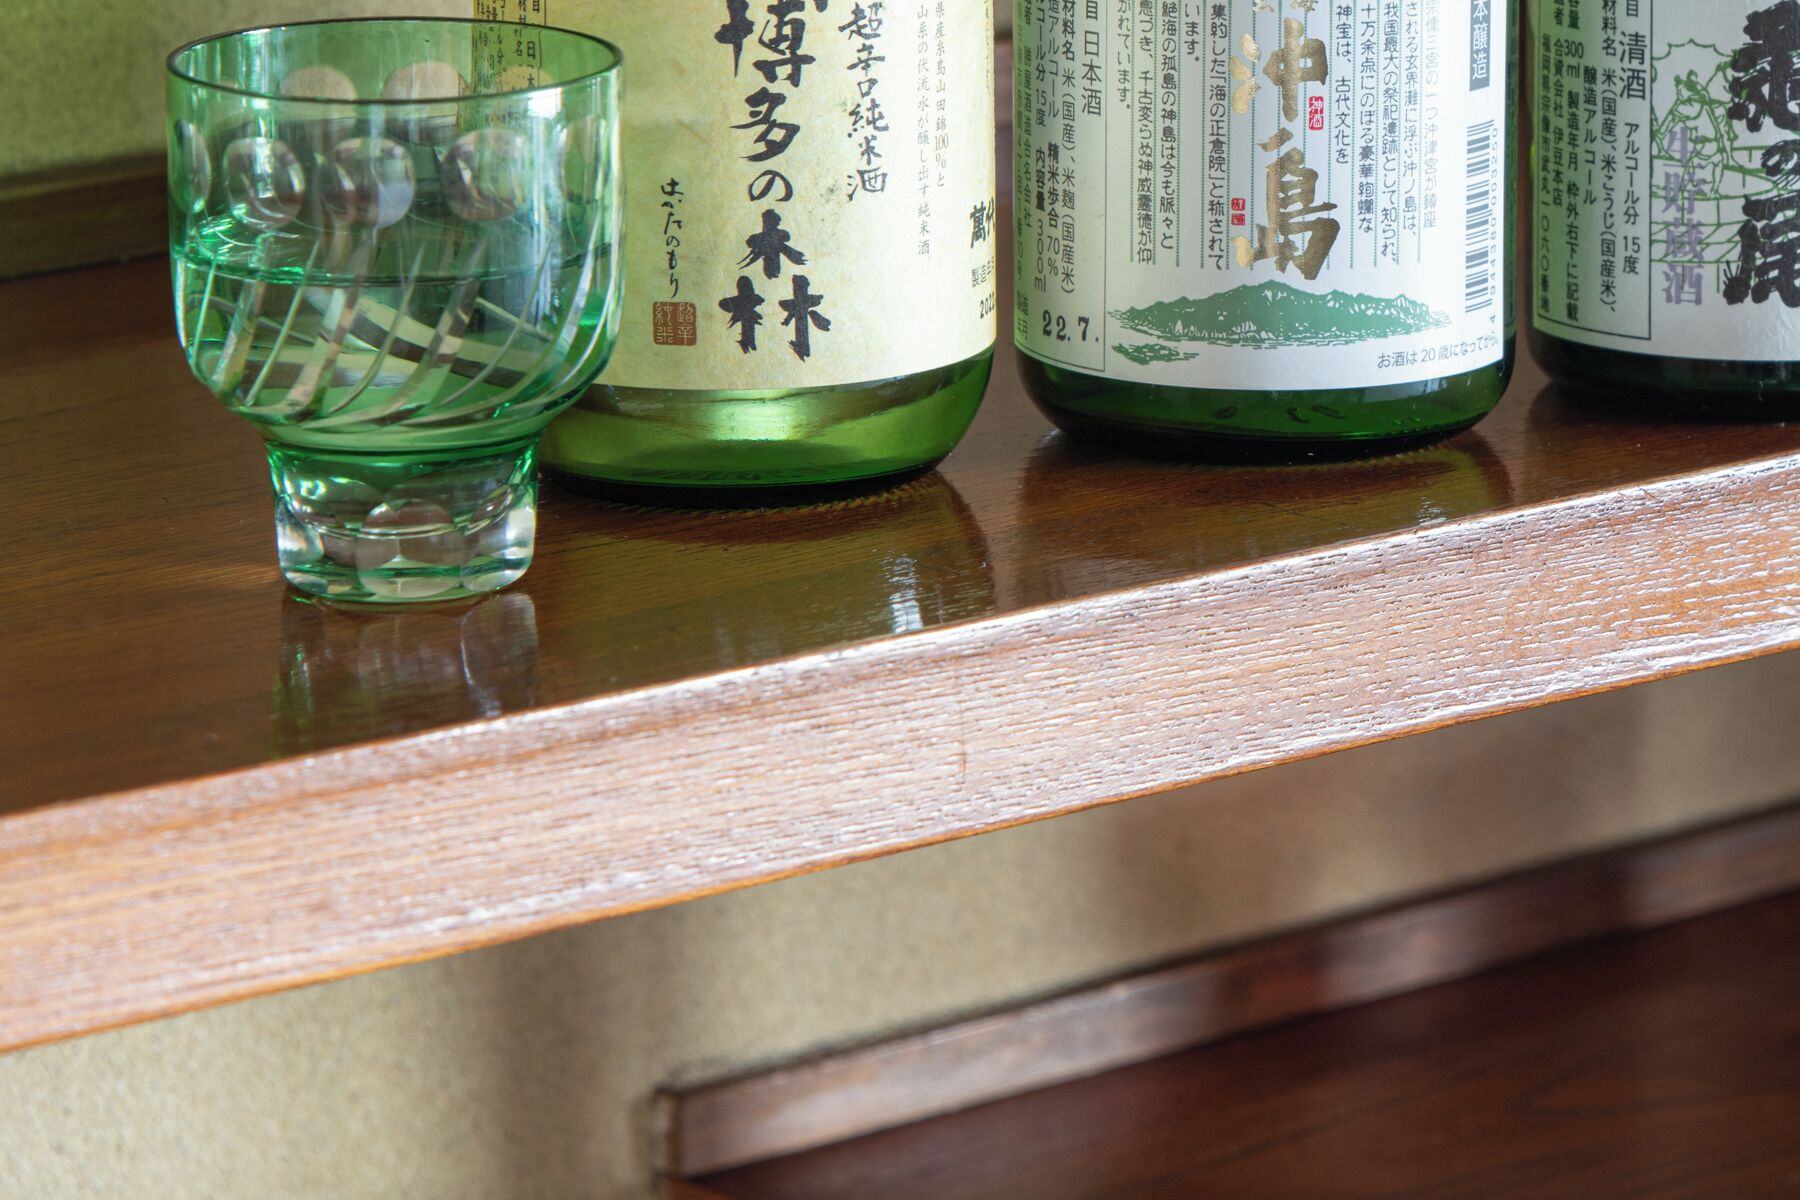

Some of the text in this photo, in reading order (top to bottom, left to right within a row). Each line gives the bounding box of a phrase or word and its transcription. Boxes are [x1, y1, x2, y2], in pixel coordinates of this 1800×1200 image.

[1081, 30, 1102, 117] 日本酒
[1184, 3, 1200, 63] います。
[1564, 39, 1584, 80] 300ml
[1619, 31, 1648, 101] 清酒
[837, 0, 890, 201] 超辛口純米酒
[1160, 1, 1177, 250] 絶海の孤島の神島は今も脈々と
[1208, 3, 1227, 271] 集約した「海の正倉院」と称されて
[1567, 90, 1580, 172] 製造年月
[1583, 65, 1598, 205] 醸造アルコール
[1035, 146, 1046, 213] 内容量
[1047, 142, 1060, 229] 精米歩合
[1623, 122, 1641, 225] アルコール分
[1662, 126, 1704, 306] 生貯蔵酒
[1034, 219, 1047, 294] 300ml
[1047, 235, 1060, 276] 70%
[1566, 180, 1580, 323] 枠外右下に記載
[1622, 236, 1641, 275] 15度
